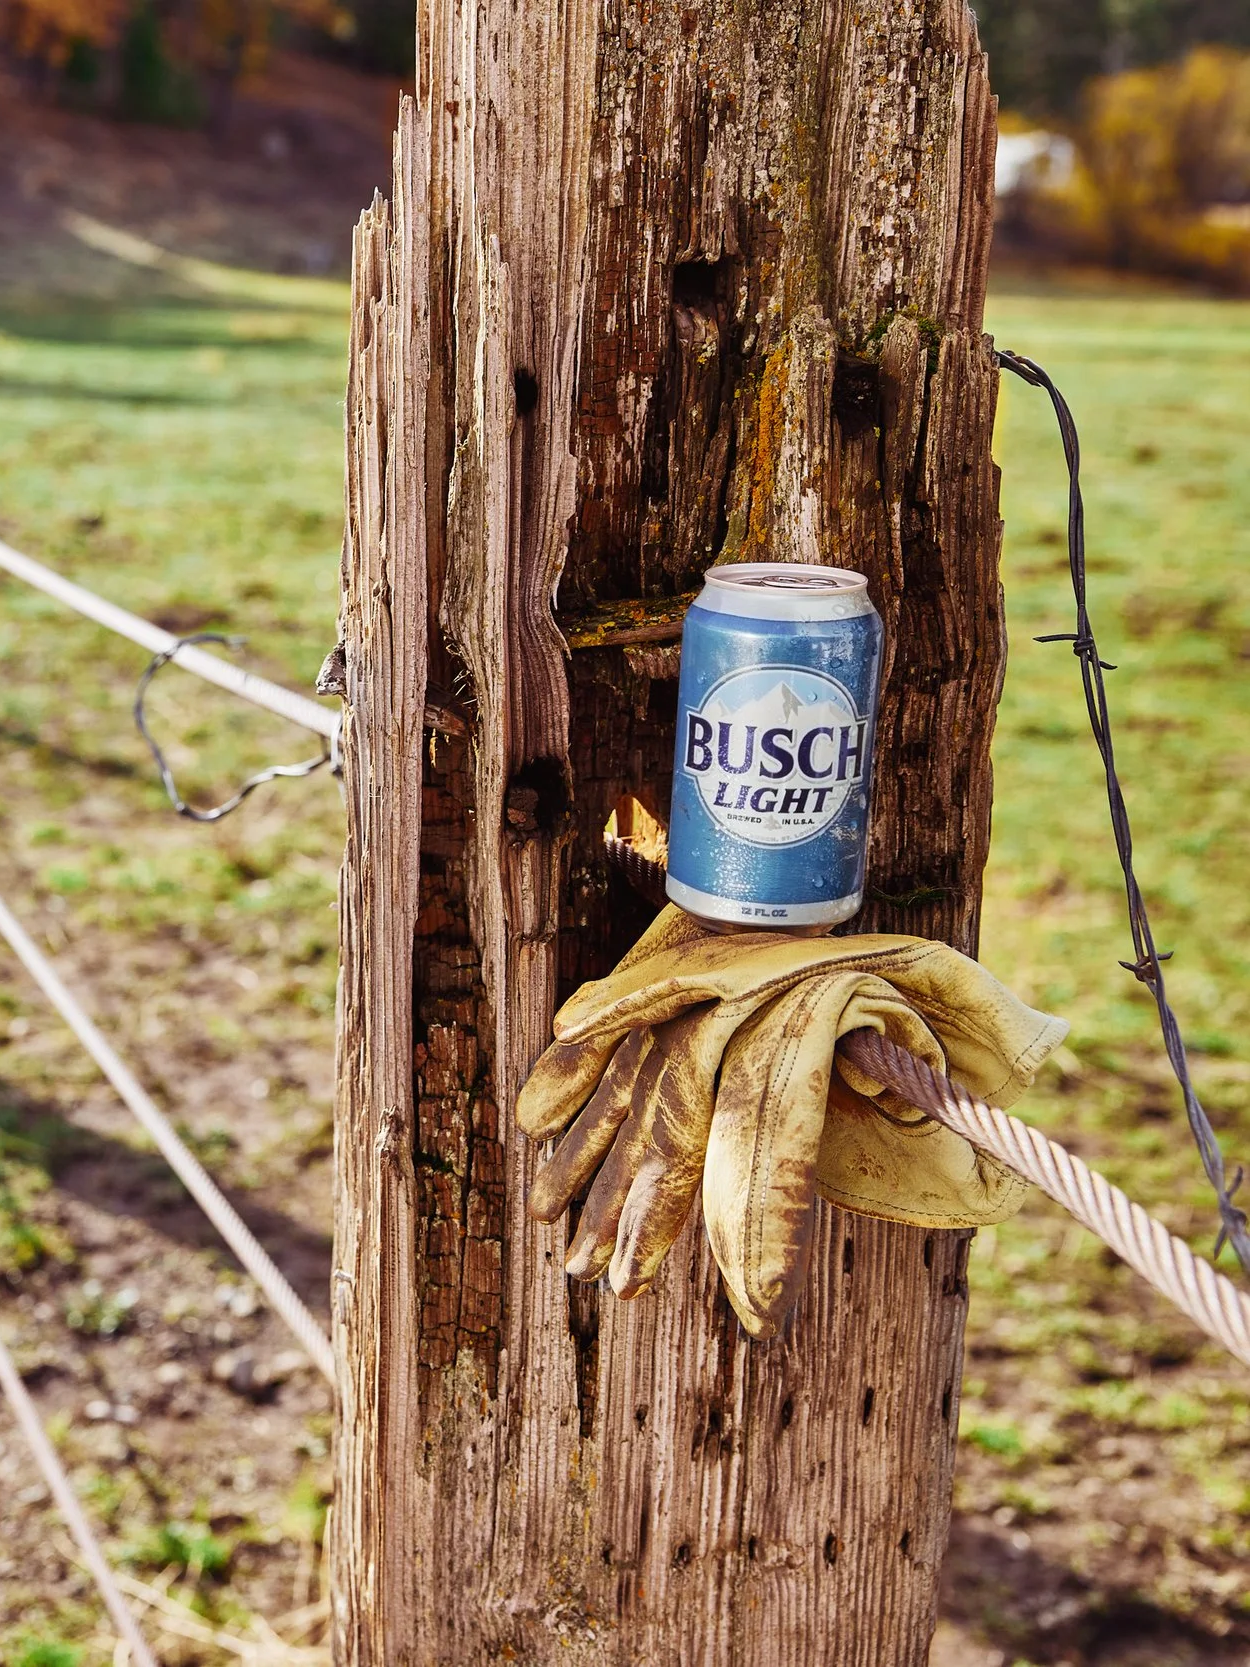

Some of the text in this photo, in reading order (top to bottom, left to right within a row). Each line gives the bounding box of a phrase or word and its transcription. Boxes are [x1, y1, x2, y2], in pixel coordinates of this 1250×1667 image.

[685, 713, 866, 782] BUSCH
[713, 781, 834, 814] LIGHT
[726, 813, 762, 824] BREWED
